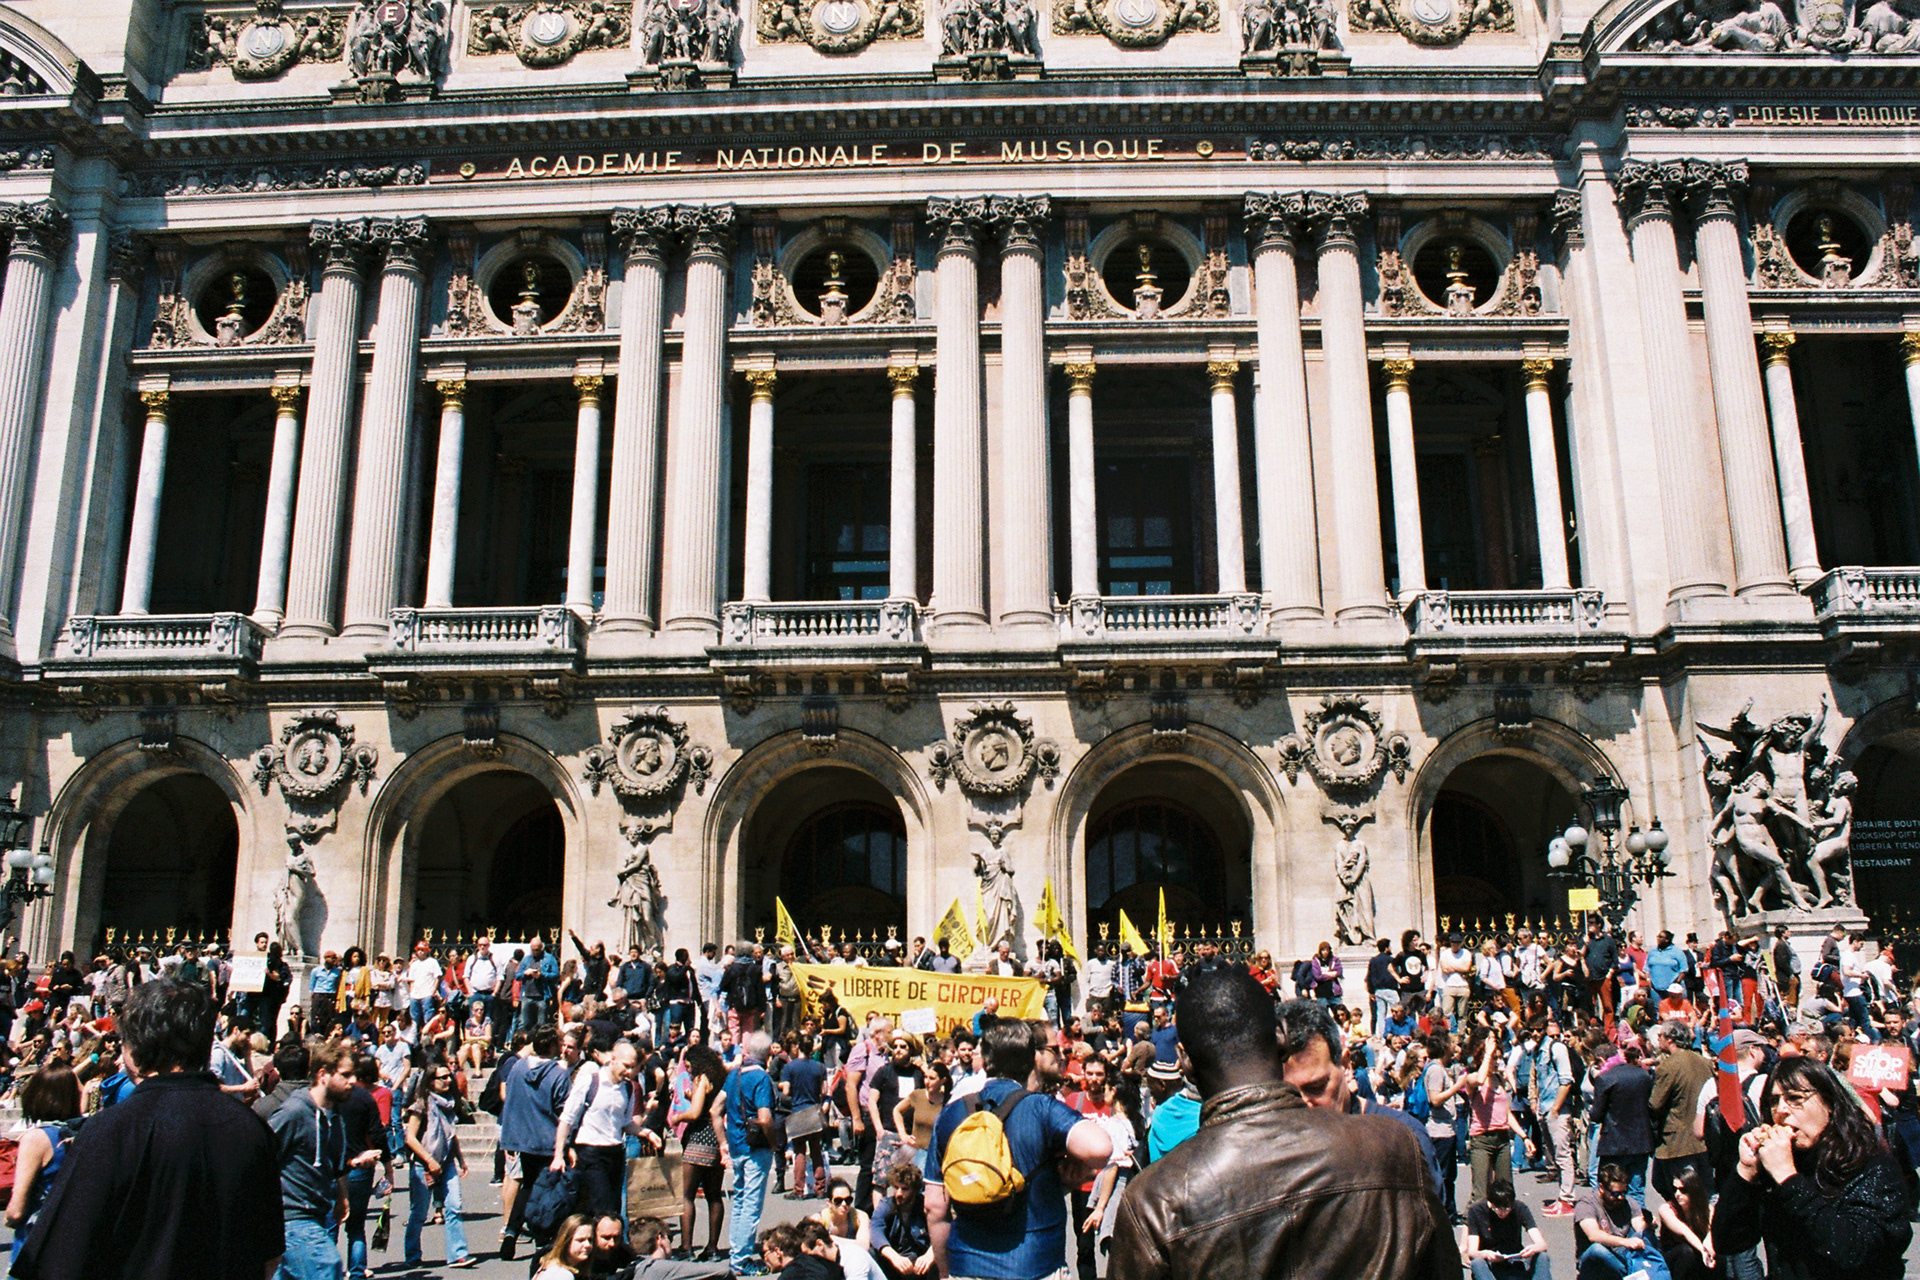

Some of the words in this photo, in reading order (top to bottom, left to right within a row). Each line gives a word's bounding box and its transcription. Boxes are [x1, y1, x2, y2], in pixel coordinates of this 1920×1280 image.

[384, 6, 398, 22] E
[831, 5, 849, 24] N
[539, 18, 557, 36] N
[256, 32, 273, 50] N
[1748, 106, 1823, 125] POESIE
[1836, 106, 1919, 126] LYRIQUE
[505, 151, 682, 178] ACADEMIE
[717, 145, 888, 169] NATIONALE
[922, 142, 967, 164] DE
[1001, 139, 1165, 161] MUSIQUE
[1851, 820, 1891, 829] IBRAIRIE
[1853, 858, 1911, 867] RESTAURANT
[908, 981, 928, 1001] DE
[1854, 1053, 1903, 1072] STOP
